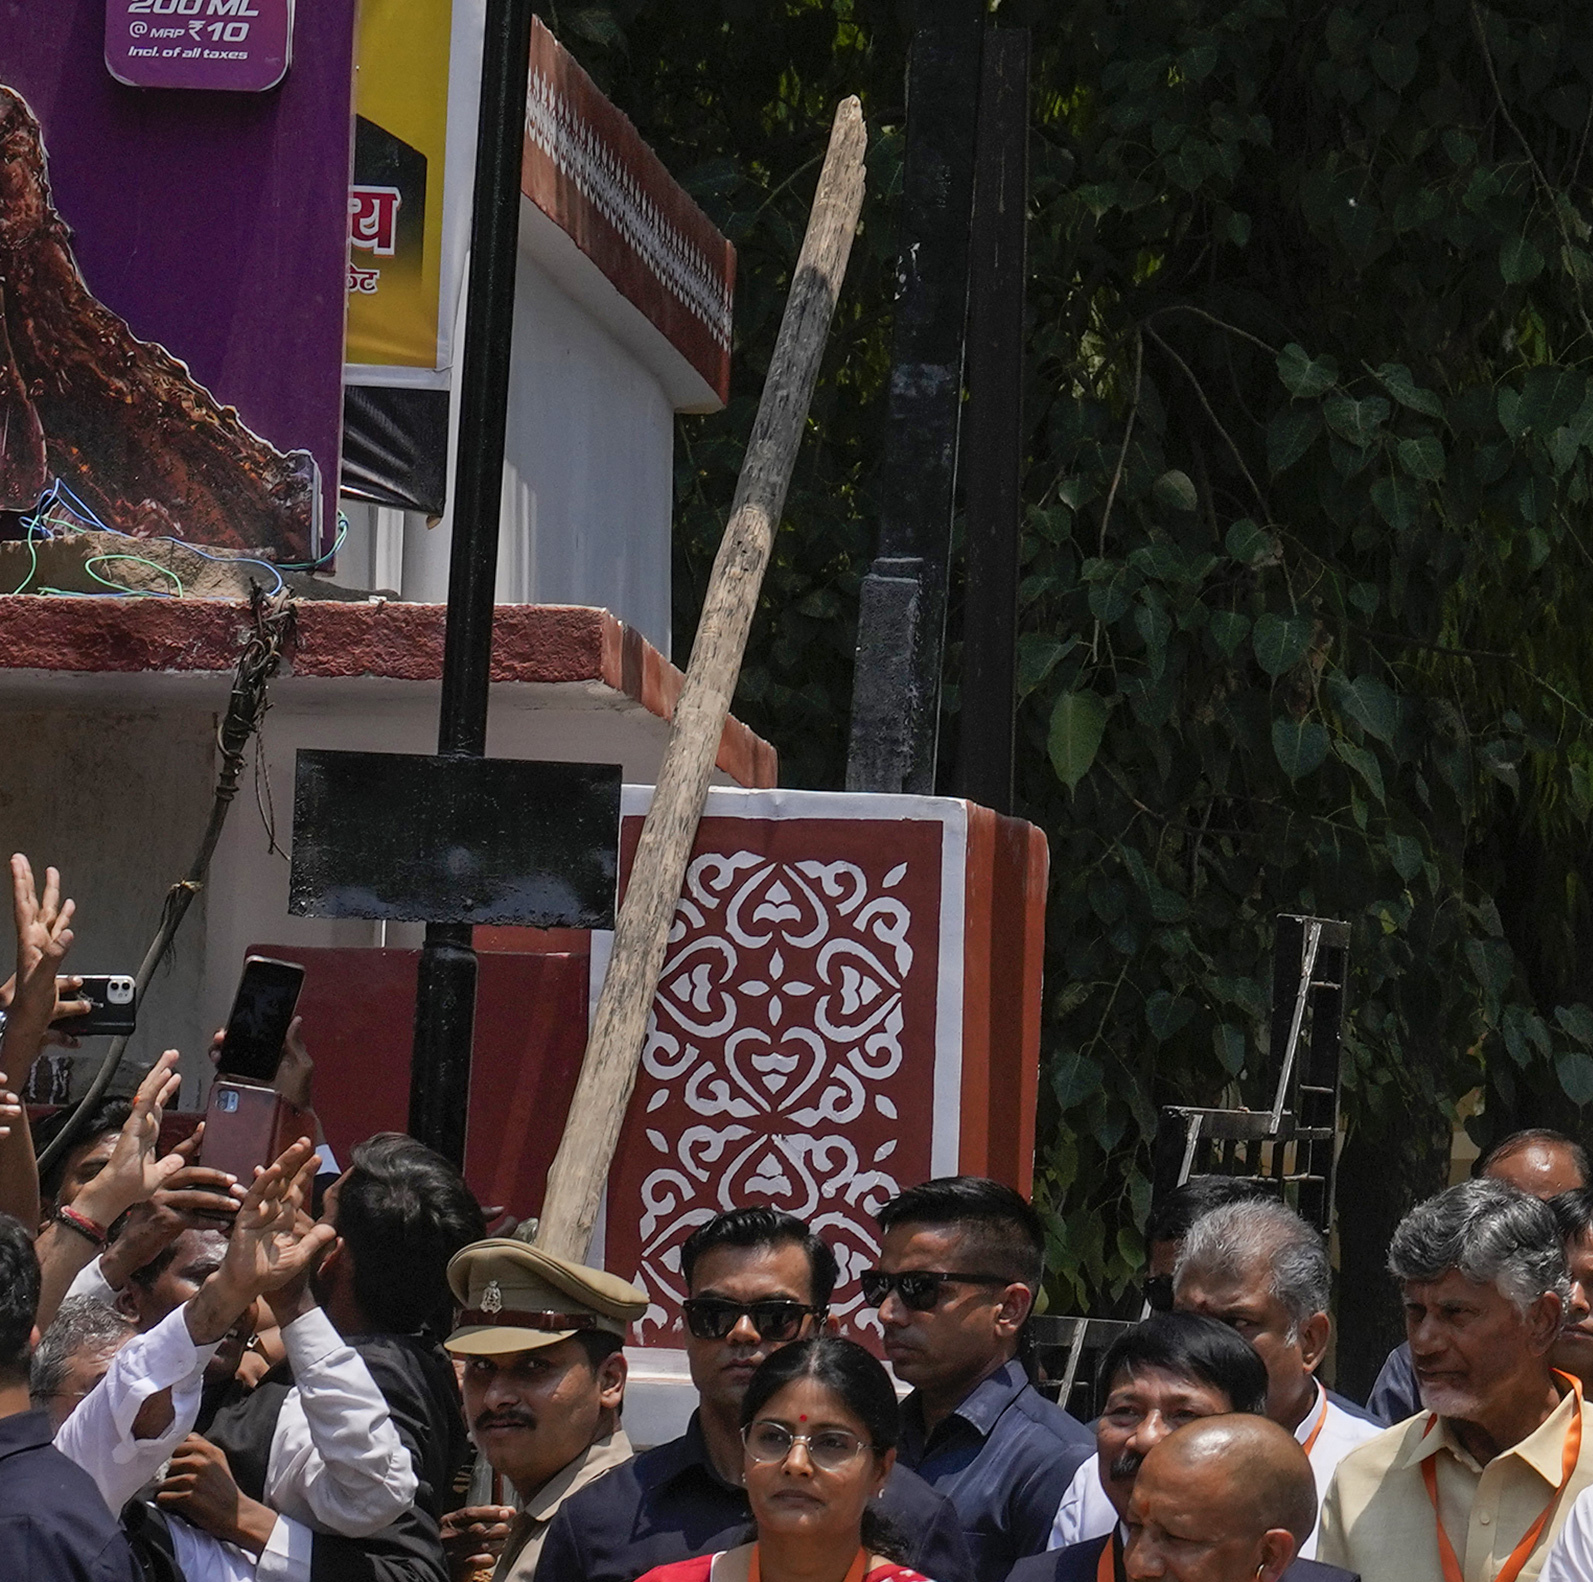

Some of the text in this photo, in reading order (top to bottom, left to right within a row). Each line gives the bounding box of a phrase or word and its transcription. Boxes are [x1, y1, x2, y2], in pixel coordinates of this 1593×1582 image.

[129, 21, 148, 38] @
[150, 28, 185, 39] MRP
[128, 46, 248, 60] Incl. of all taxes
